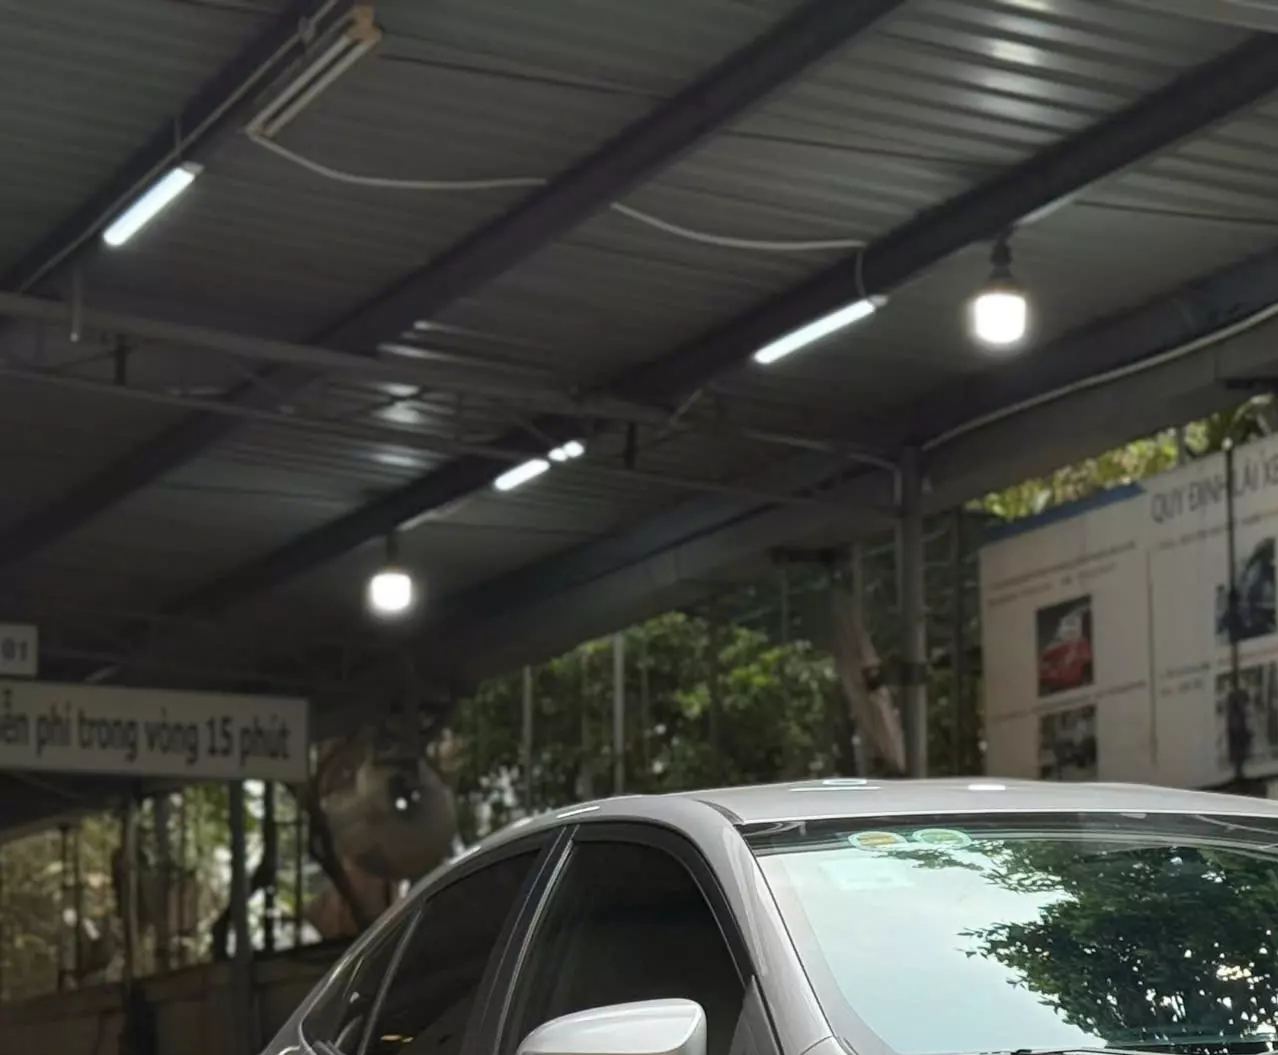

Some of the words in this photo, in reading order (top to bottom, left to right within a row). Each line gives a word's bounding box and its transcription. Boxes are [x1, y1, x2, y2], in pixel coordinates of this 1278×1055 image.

[1151, 487, 1185, 523] QUY
[78, 708, 138, 764] trong
[144, 707, 199, 767] vòng
[205, 716, 234, 757] 15
[239, 713, 290, 767] phút
